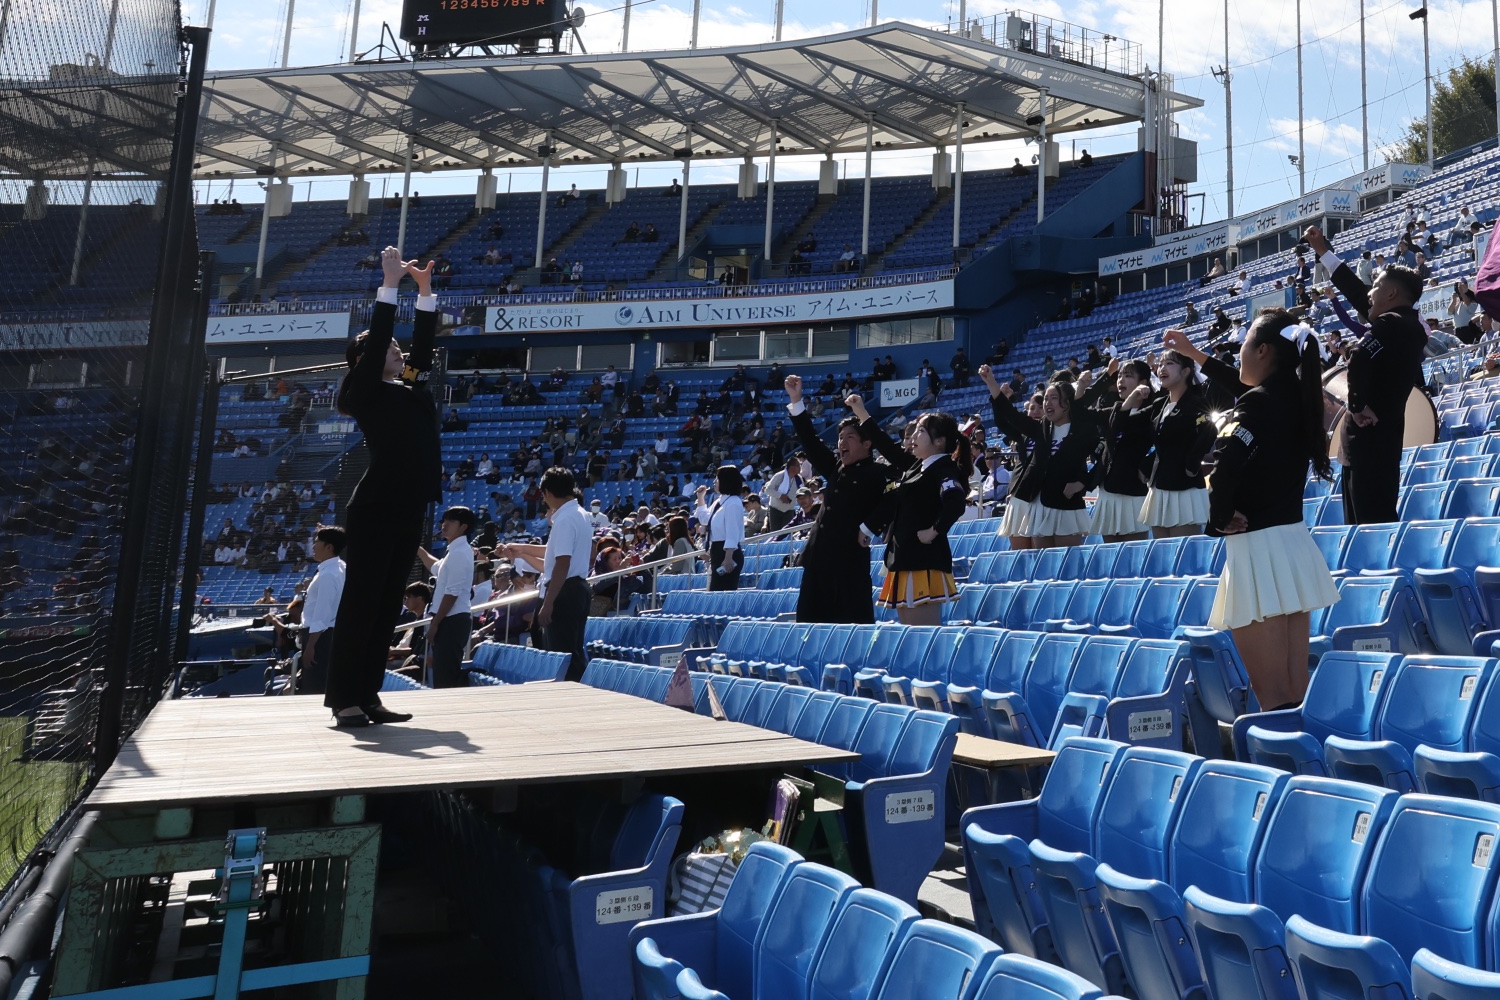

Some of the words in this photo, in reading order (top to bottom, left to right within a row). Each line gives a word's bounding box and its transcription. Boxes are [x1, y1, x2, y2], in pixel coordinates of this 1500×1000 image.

[418, 27, 426, 35] H
[1363, 171, 1386, 190] マイナビ
[1298, 199, 1320, 216] マイナビ
[1256, 214, 1277, 229] マイナビ
[1206, 232, 1227, 247] マイナビ
[1165, 245, 1188, 260] マイナビ
[1117, 255, 1143, 269] マイナビ
[808, 289, 938, 316] アイム・ユニバース
[636, 305, 681, 324] AIM
[692, 303, 796, 322] UNIVERSE
[895, 386, 917, 398] MGC
